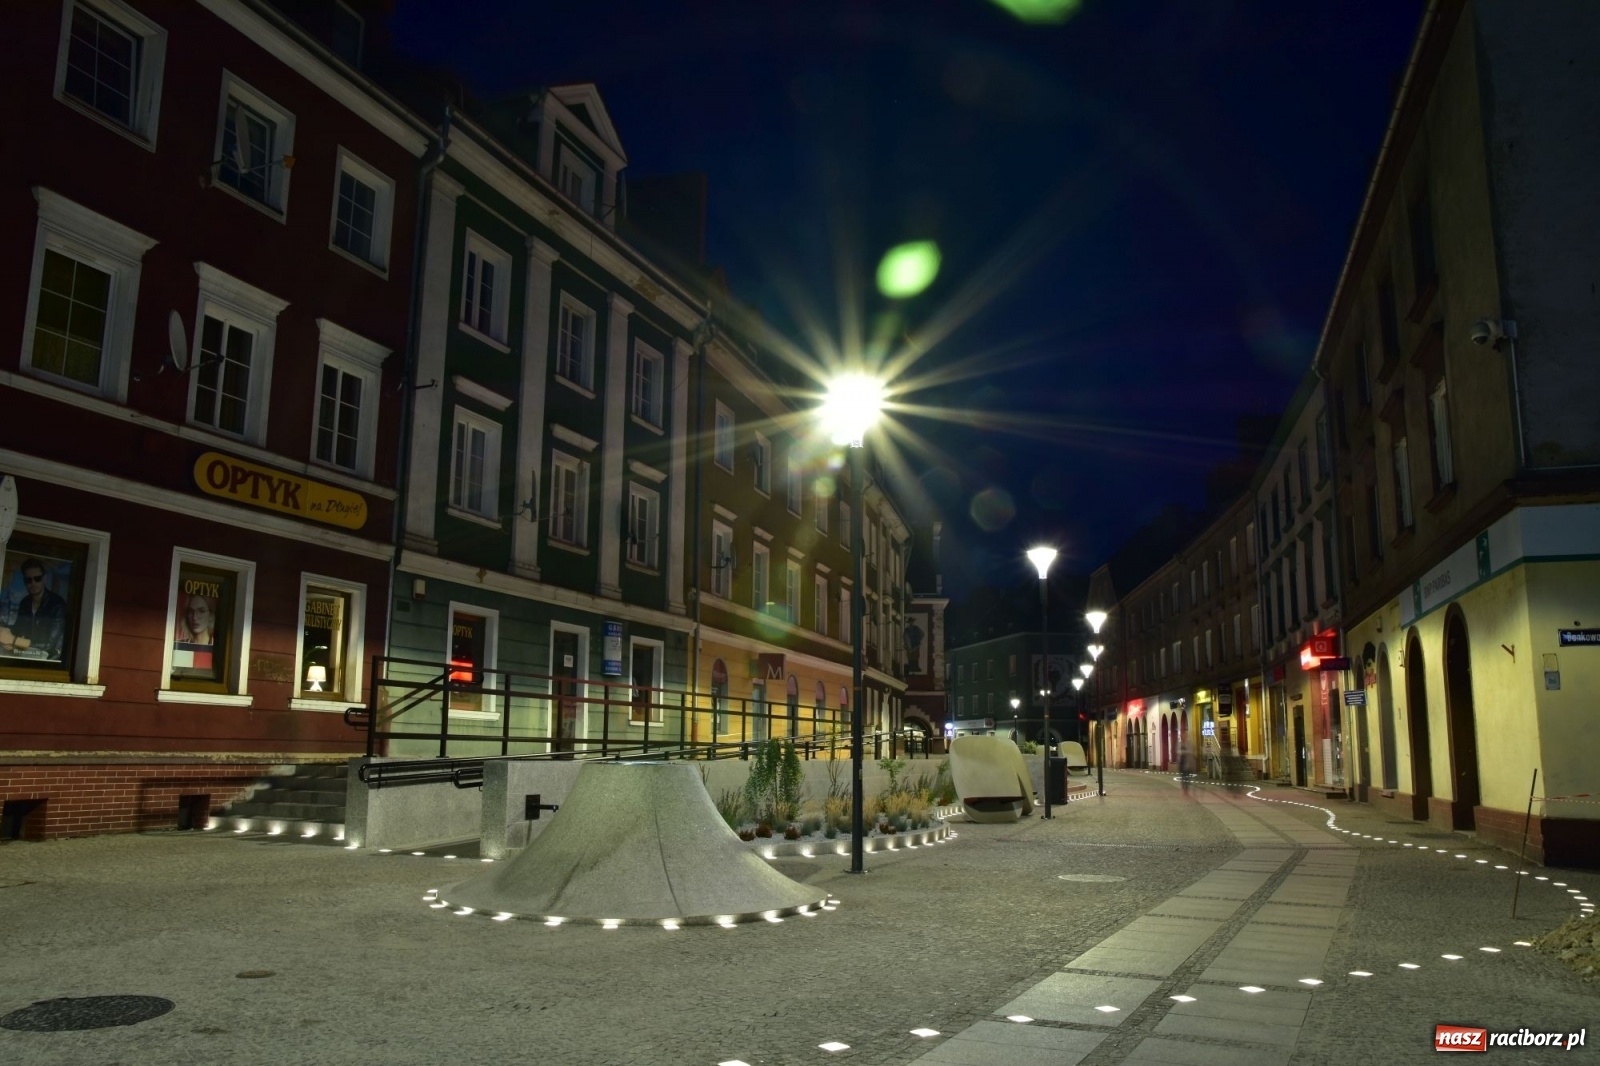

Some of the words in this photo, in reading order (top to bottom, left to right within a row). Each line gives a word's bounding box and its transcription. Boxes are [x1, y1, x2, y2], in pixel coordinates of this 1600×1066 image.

[206, 459, 301, 510] OPTYK
[310, 502, 323, 512] na
[185, 579, 220, 599] OPTYK
[304, 599, 341, 618] GABINET
